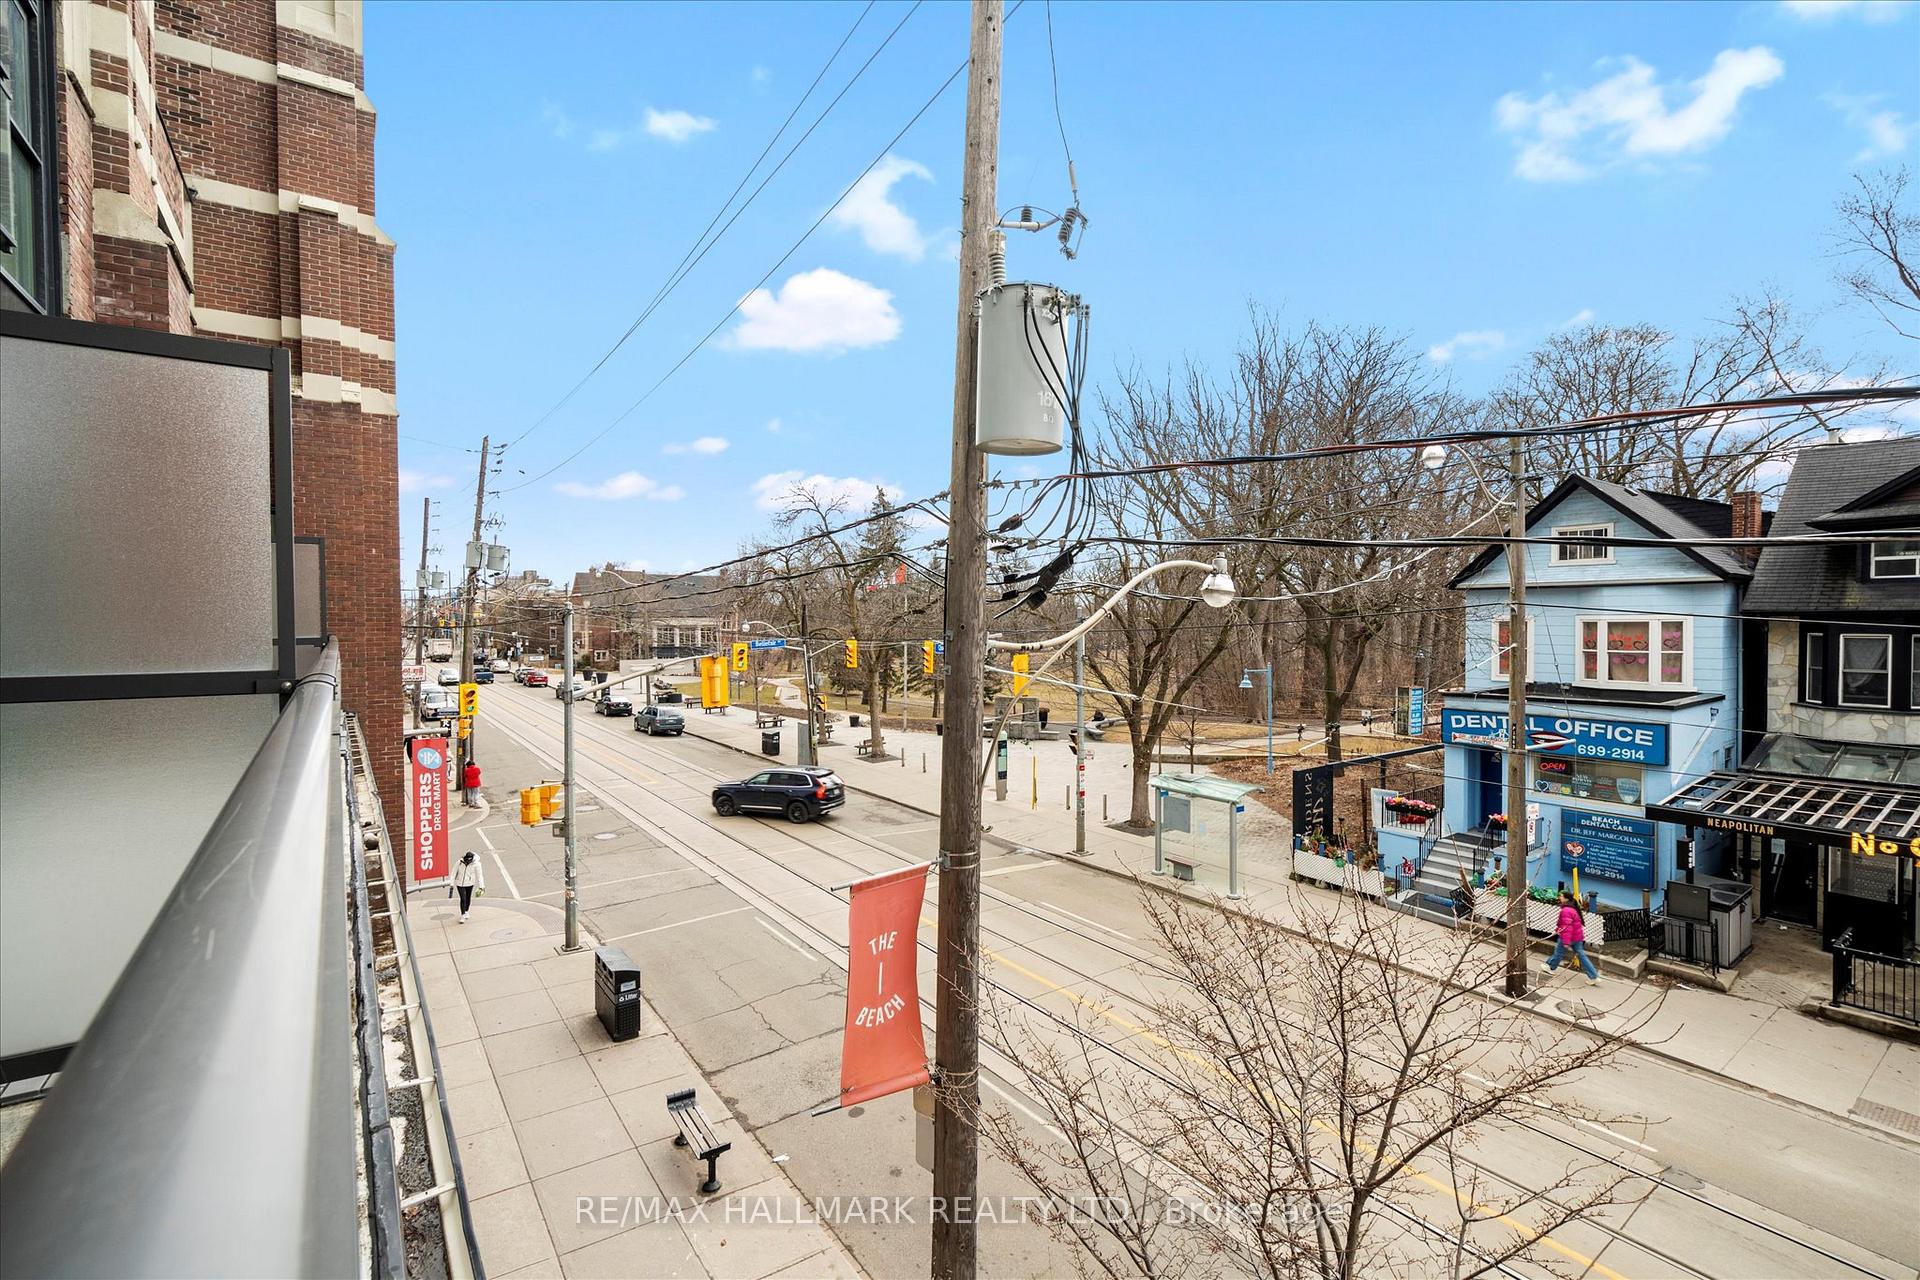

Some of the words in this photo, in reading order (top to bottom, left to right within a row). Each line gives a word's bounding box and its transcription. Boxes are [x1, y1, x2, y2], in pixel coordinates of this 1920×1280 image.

[1450, 715, 1544, 731] DENTL
[1554, 718, 1654, 746] OFFICE
[1577, 744, 1645, 760] 699-2914
[1540, 762, 1566, 771] OPEN
[433, 771, 441, 801] MART
[419, 772, 433, 871] SHOPPERS
[433, 800, 441, 831] DRUG
[1581, 819, 1611, 829] DENTAL
[1612, 824, 1633, 832] CARE
[1592, 816, 1620, 825] BEACH
[1706, 817, 1774, 836] NEAPOLITAN
[1851, 832, 1898, 856] No
[1584, 867, 1625, 880] 699-2914
[868, 931, 898, 956] THE
[855, 993, 906, 1028] BEACH
